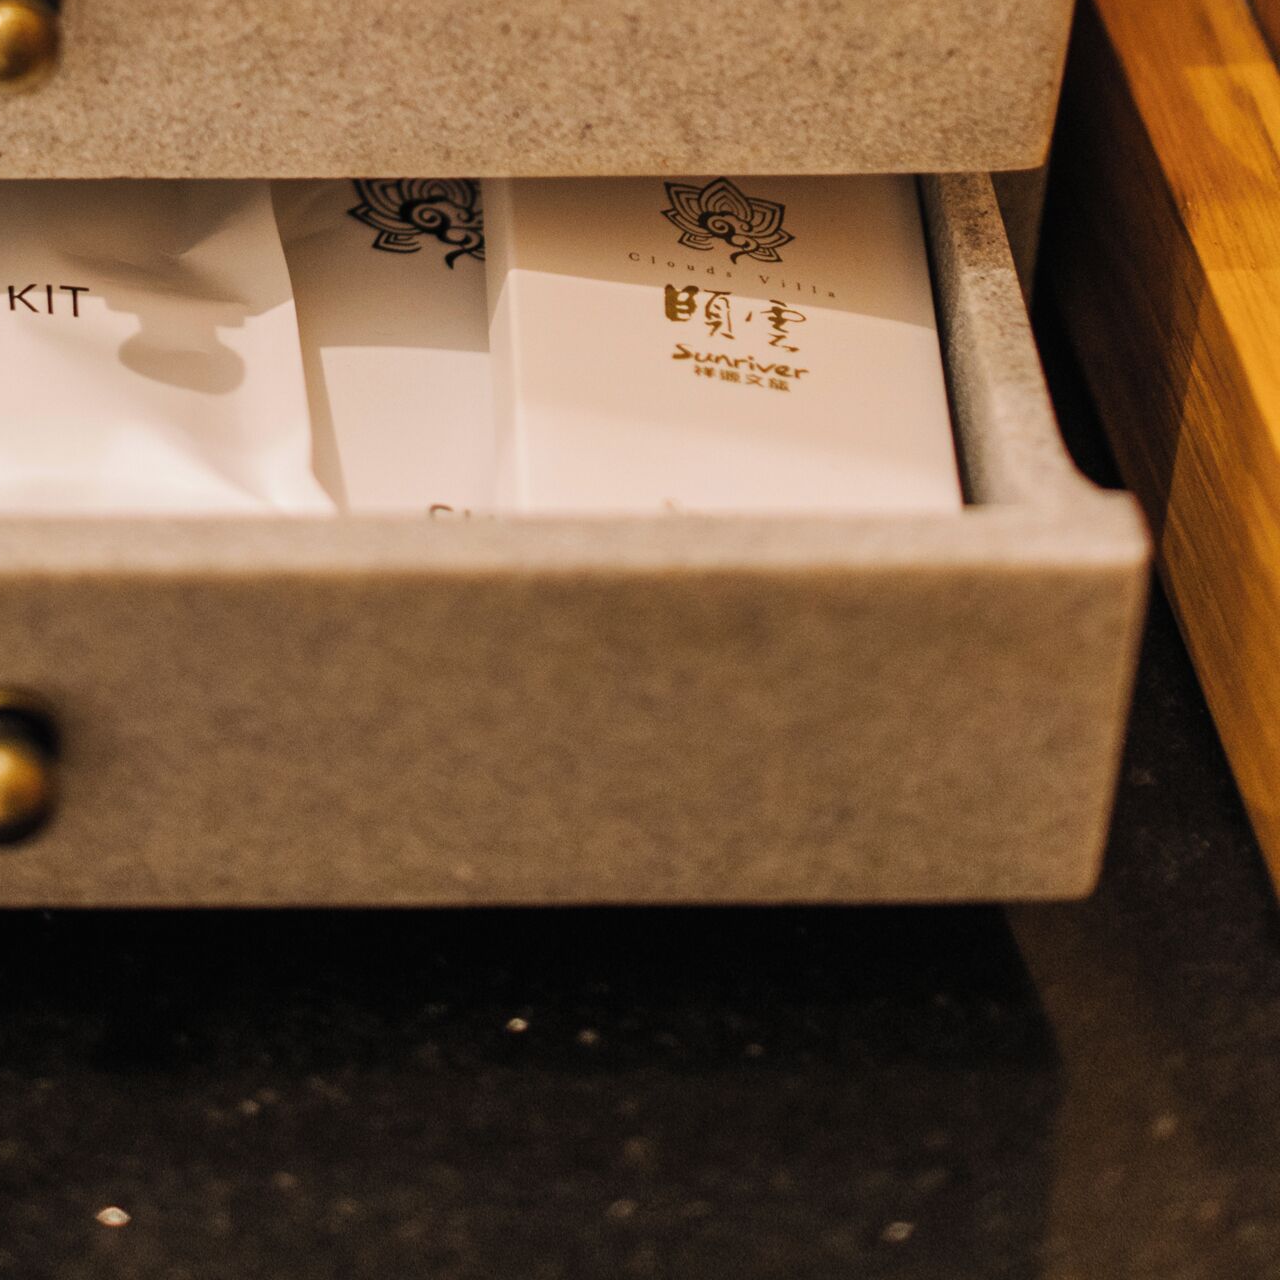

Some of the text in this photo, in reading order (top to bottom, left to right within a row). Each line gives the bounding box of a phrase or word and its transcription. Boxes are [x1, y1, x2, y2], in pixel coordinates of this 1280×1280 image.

[627, 250, 837, 299] Clouds Villa
[7, 283, 91, 318] KIT
[671, 343, 810, 380] Sunriver
